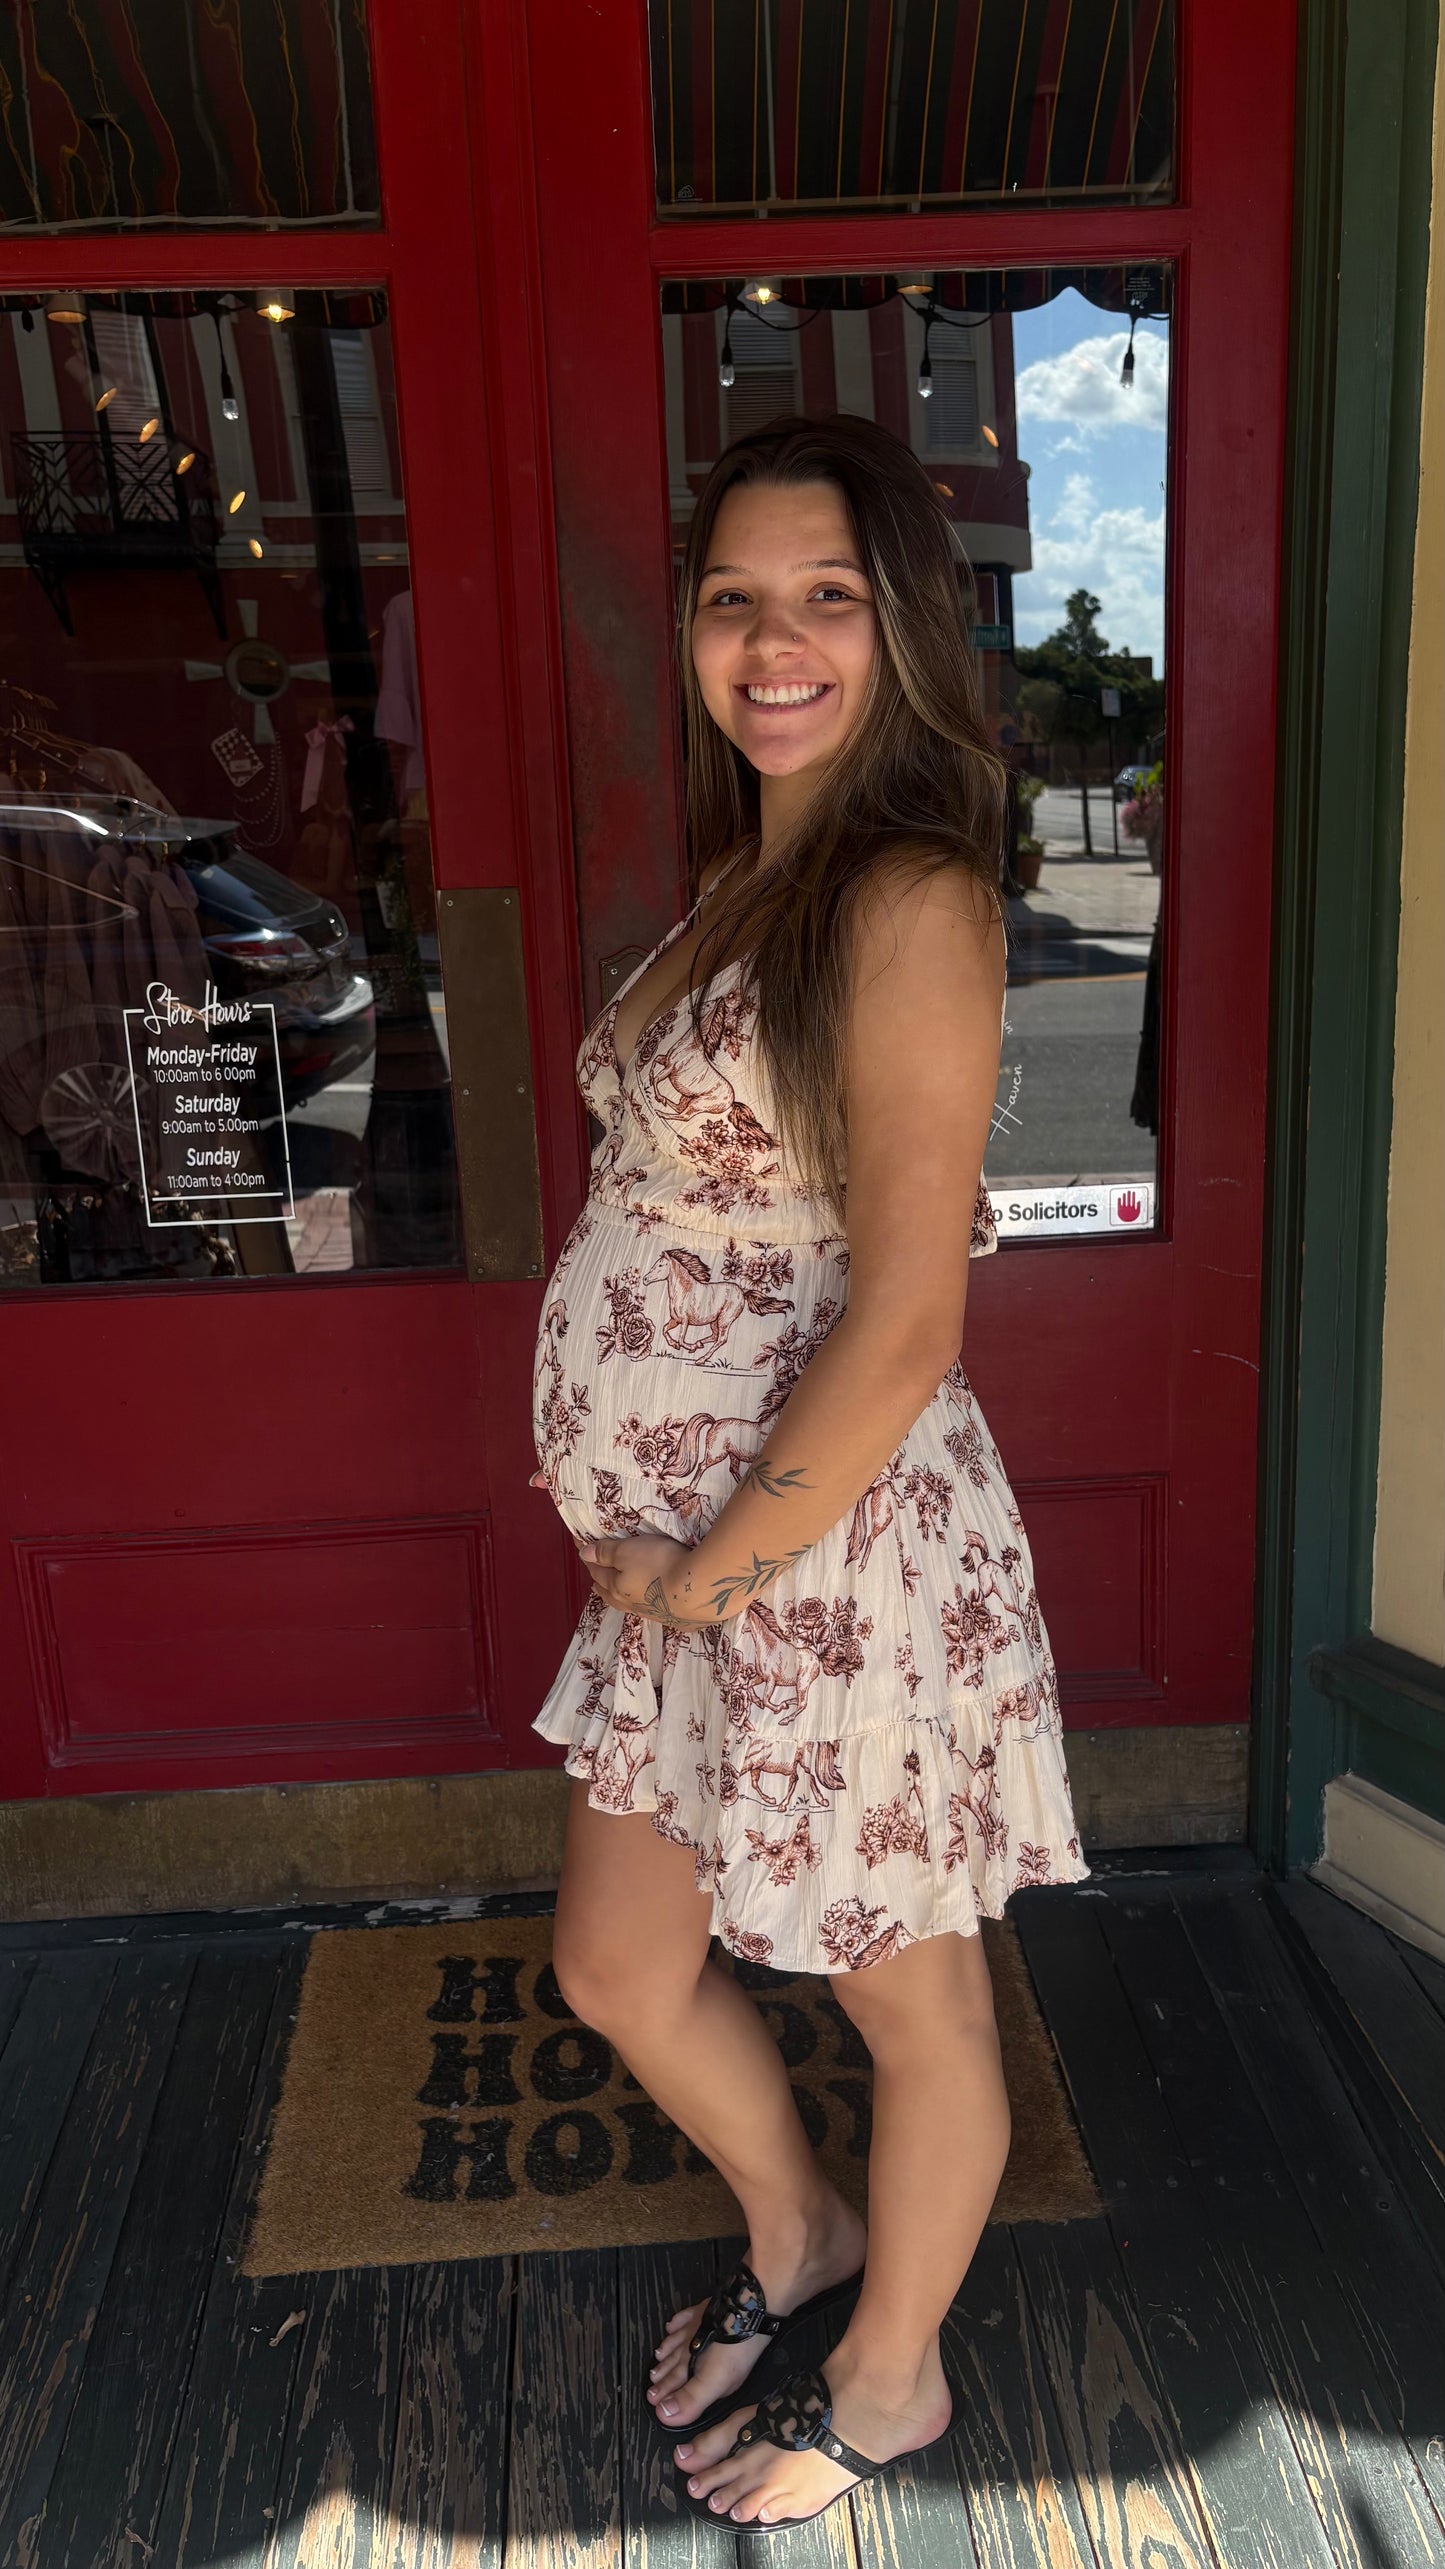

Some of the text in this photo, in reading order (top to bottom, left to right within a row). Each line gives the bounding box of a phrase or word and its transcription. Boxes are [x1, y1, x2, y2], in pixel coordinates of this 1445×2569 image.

[144, 979, 253, 1035] Store Hours
[147, 1043, 257, 1067] Monday-Friday
[154, 1069, 199, 1084] 10:00am
[201, 1068, 213, 1082] to
[175, 1092, 241, 1115] Saturday
[990, 1063, 1022, 1141] Haven
[162, 1120, 202, 1135] 9:00am
[204, 1119, 216, 1132] to
[186, 1146, 241, 1168] Sunday
[167, 1174, 209, 1189] 11:00am
[210, 1173, 222, 1187] to
[1008, 1201, 1098, 1222] Solicitors
